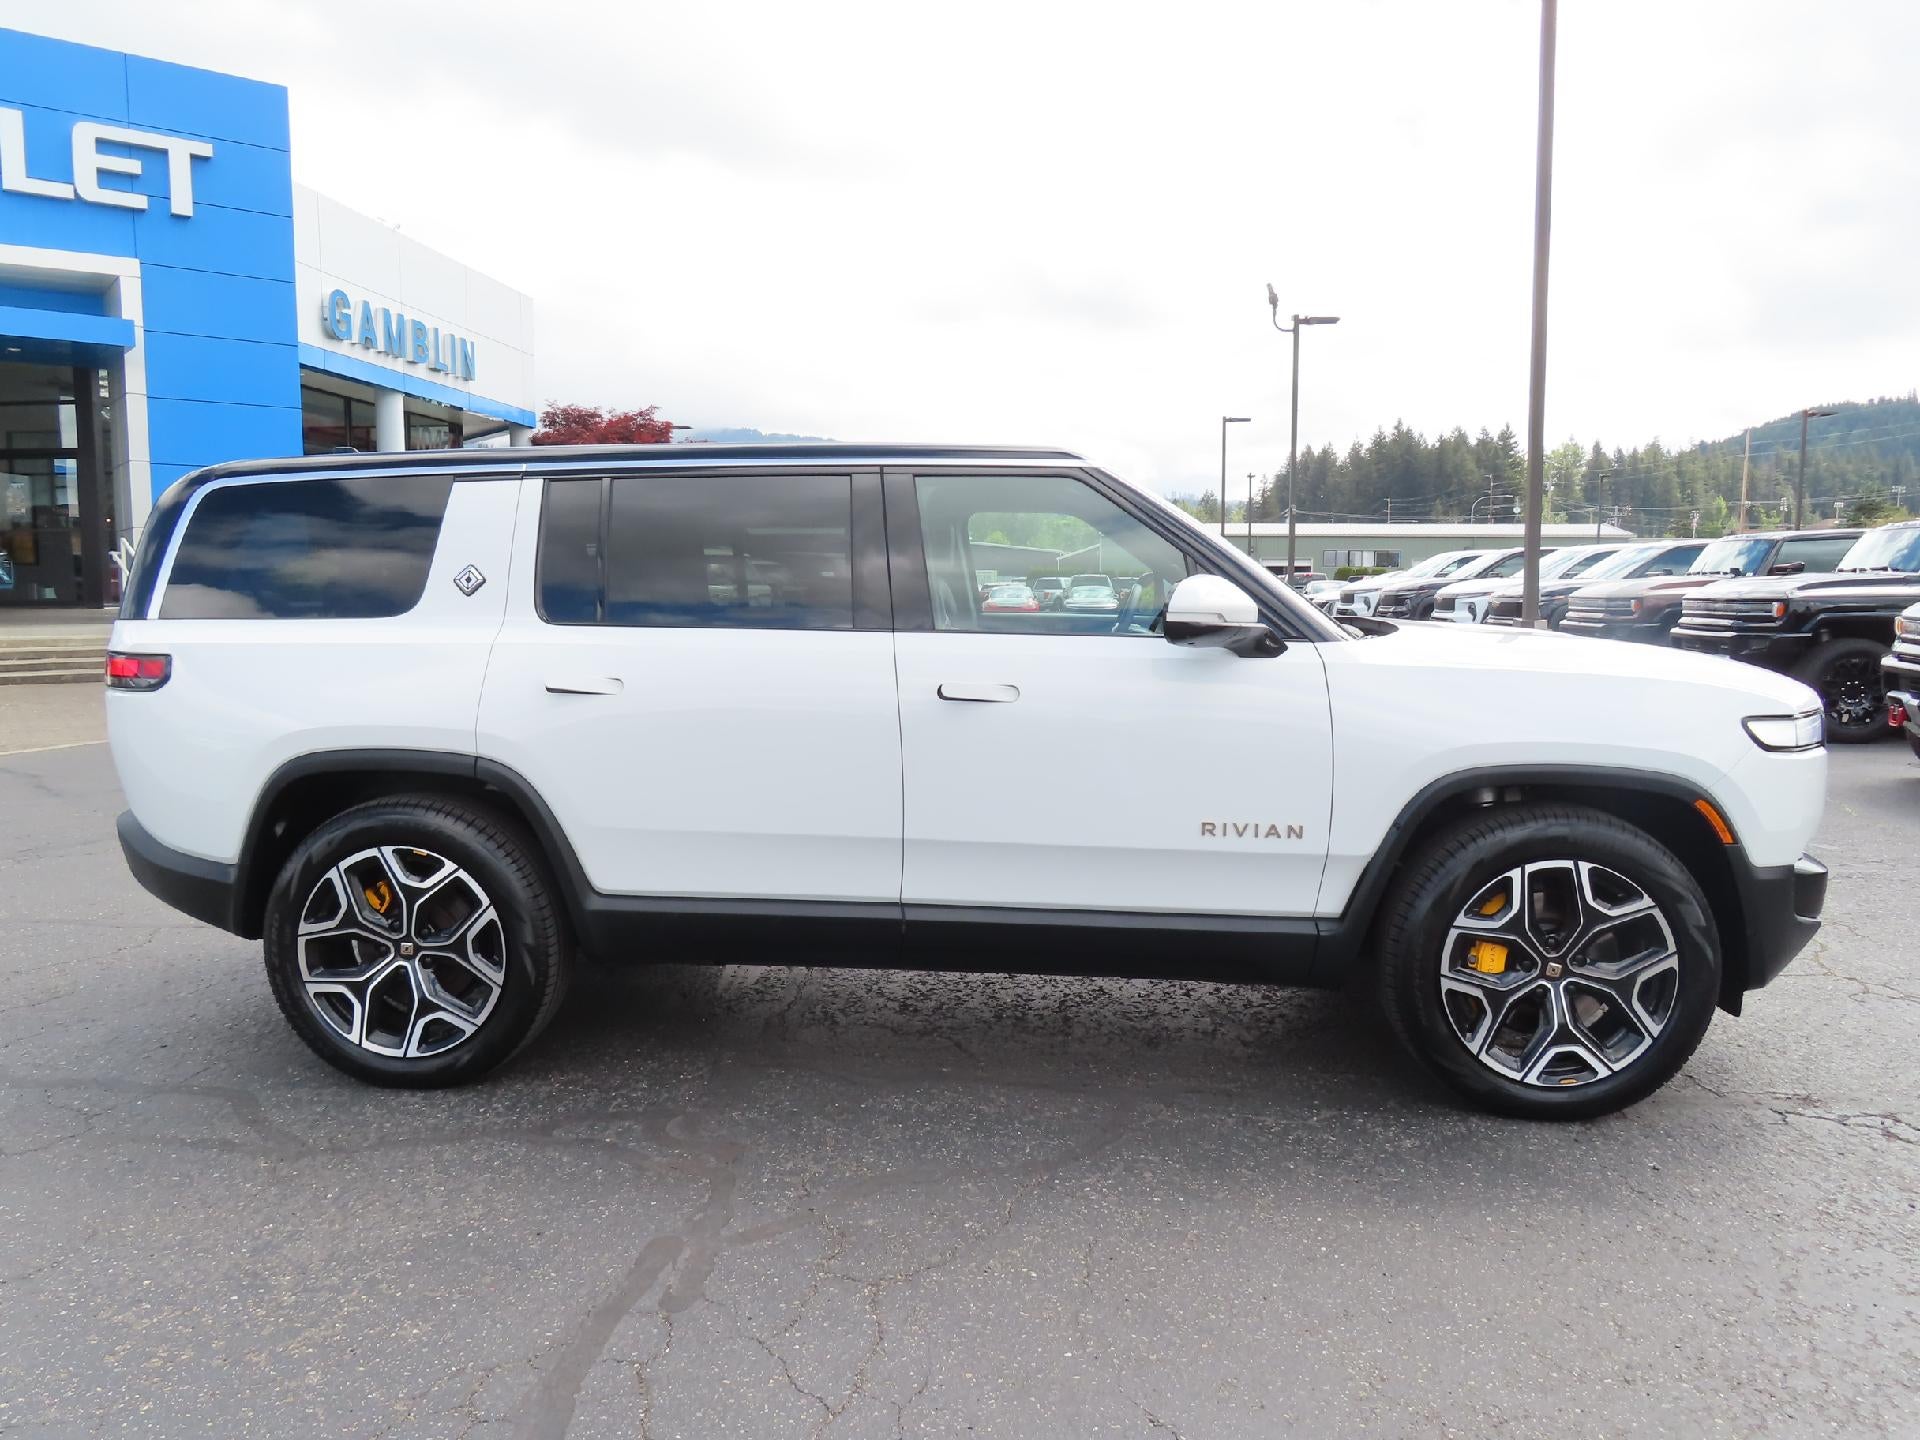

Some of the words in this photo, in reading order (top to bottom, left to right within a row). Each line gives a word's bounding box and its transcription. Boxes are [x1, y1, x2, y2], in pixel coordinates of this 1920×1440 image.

[0, 106, 214, 217] LET
[323, 289, 476, 381] GAMBLIN
[1201, 822, 1304, 840] RIVIAN
